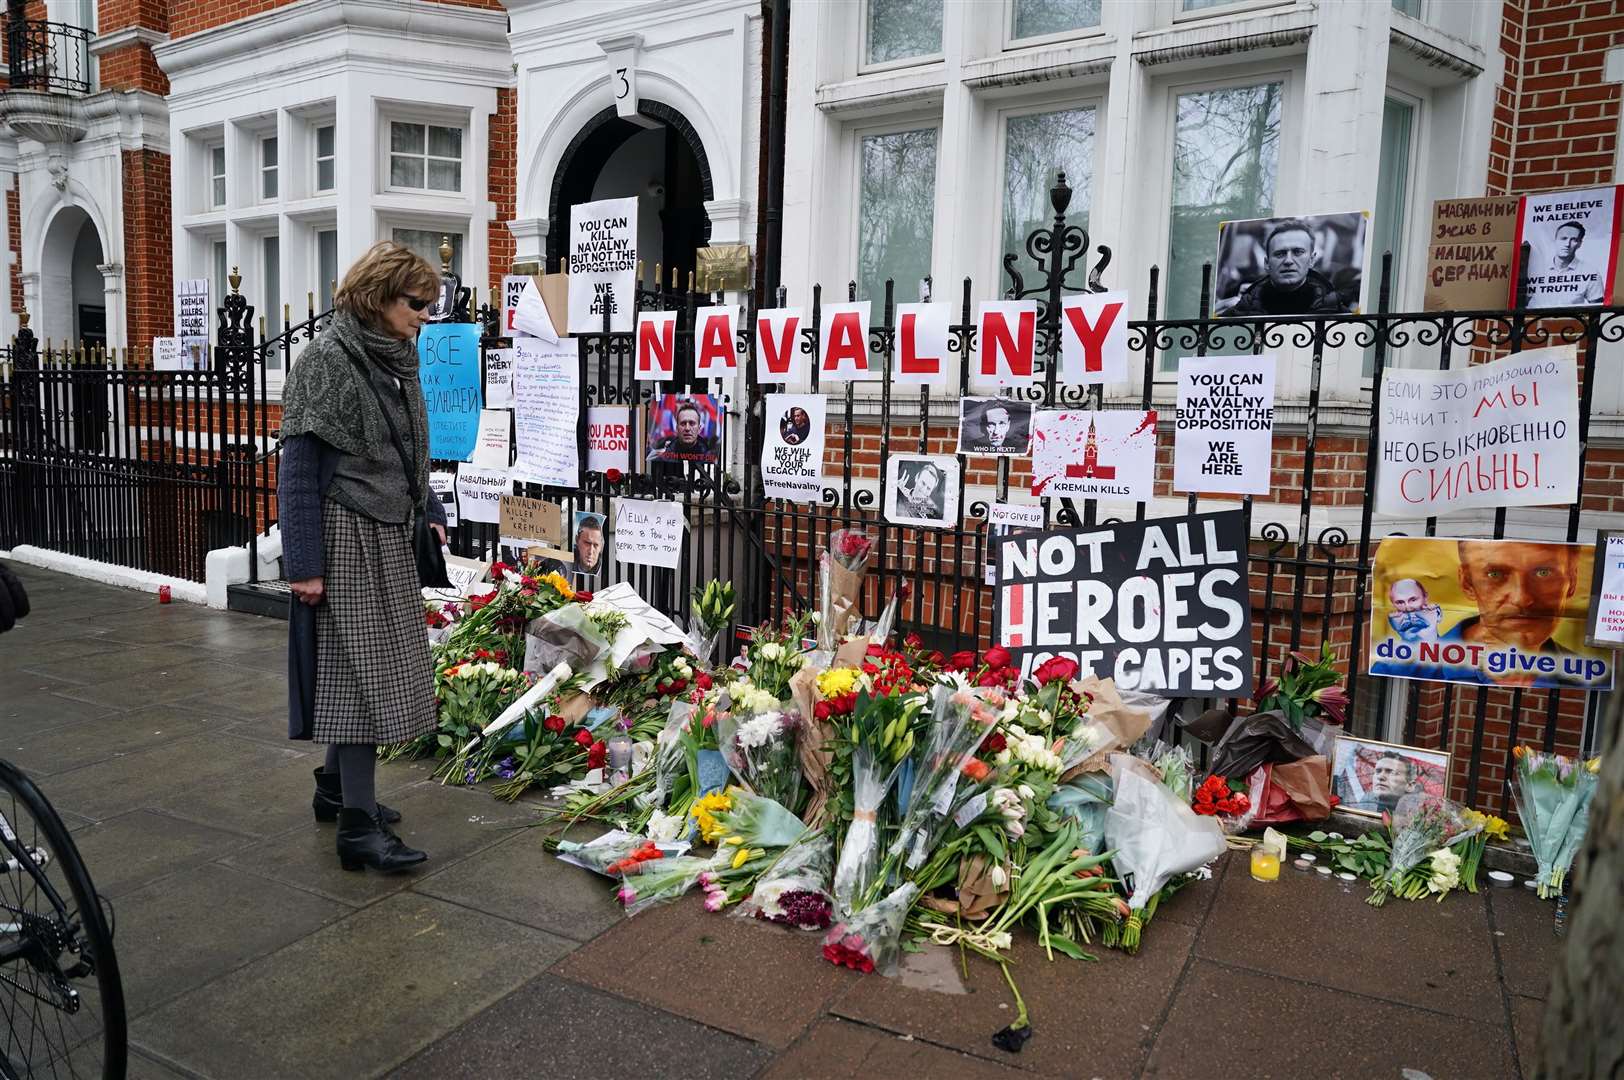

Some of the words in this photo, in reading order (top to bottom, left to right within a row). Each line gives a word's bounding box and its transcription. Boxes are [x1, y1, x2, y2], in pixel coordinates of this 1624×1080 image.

[616, 67, 629, 99] 3
[1437, 201, 1518, 219] НАВАЛЬНЫЙ
[1534, 204, 1552, 213] WE
[1555, 200, 1603, 211] BELIEVE
[1532, 215, 1544, 223] IN
[1547, 211, 1591, 221] ALEXEY
[579, 220, 601, 232] YOU
[604, 217, 627, 230] CAN
[591, 230, 614, 241] KILL
[577, 239, 629, 253] NAVALNY
[571, 253, 589, 264] BUT
[591, 251, 614, 262] NOT
[615, 249, 636, 260] THE
[572, 260, 634, 273] OPPOSITION
[1526, 276, 1545, 285] WE
[1548, 273, 1598, 283] BELIEVE
[594, 283, 612, 293] WE
[1539, 284, 1578, 293] TRUTH
[181, 298, 205, 306] KREMLIN
[593, 293, 615, 304] AE
[426, 335, 462, 366] ВСЕ
[487, 353, 500, 362] NO
[448, 374, 455, 385] У
[1190, 374, 1224, 386] YOU
[1229, 373, 1263, 385] CAN
[1209, 385, 1243, 397] KILL
[1387, 382, 1421, 400] ЕСЛИ
[1430, 383, 1468, 401] ЭТО
[425, 386, 478, 415] Е)ЛЮДЕЙ
[1186, 396, 1264, 408] NAVALNY
[1472, 381, 1541, 419] МЫ
[1176, 408, 1206, 419] BUT
[1210, 408, 1242, 419] NOT
[1246, 408, 1273, 419] THE
[1177, 419, 1271, 430] OPPOSITION
[603, 424, 631, 438] ARE
[588, 440, 598, 450] OT
[598, 439, 628, 451] ALON
[1208, 441, 1235, 452] WE
[1384, 420, 1567, 463] НЕОБЫКНОВЕННО
[774, 446, 788, 455] WE
[790, 447, 811, 456] WILL
[774, 453, 792, 461] NOT
[794, 454, 809, 463] LET
[1207, 453, 1239, 464] ARE
[779, 460, 803, 469] YOUR
[1201, 464, 1243, 475] HERE
[766, 466, 799, 475] LEGACY
[801, 468, 816, 477] DIE
[459, 474, 507, 487] НАВАЛЬНЫЙ
[765, 479, 821, 492] #FreeNavalny
[1054, 482, 1098, 493] KREMLIN
[1100, 485, 1130, 495] KILLS
[502, 496, 547, 513] NAVALNY'S
[506, 507, 533, 519] KILLER
[993, 511, 1009, 519] NOT
[1010, 512, 1028, 521] GIVE
[1030, 514, 1041, 522] UP
[513, 522, 546, 534] KREMLIN
[1002, 529, 1115, 580] NOT
[1135, 519, 1238, 571] ALL
[1000, 568, 1244, 648] HEROES
[1376, 638, 1412, 660] do
[1419, 642, 1485, 666] NOT
[1487, 647, 1556, 674] give
[1563, 657, 1606, 680] up
[1018, 649, 1103, 681] OE
[1114, 646, 1244, 691] CAPES
